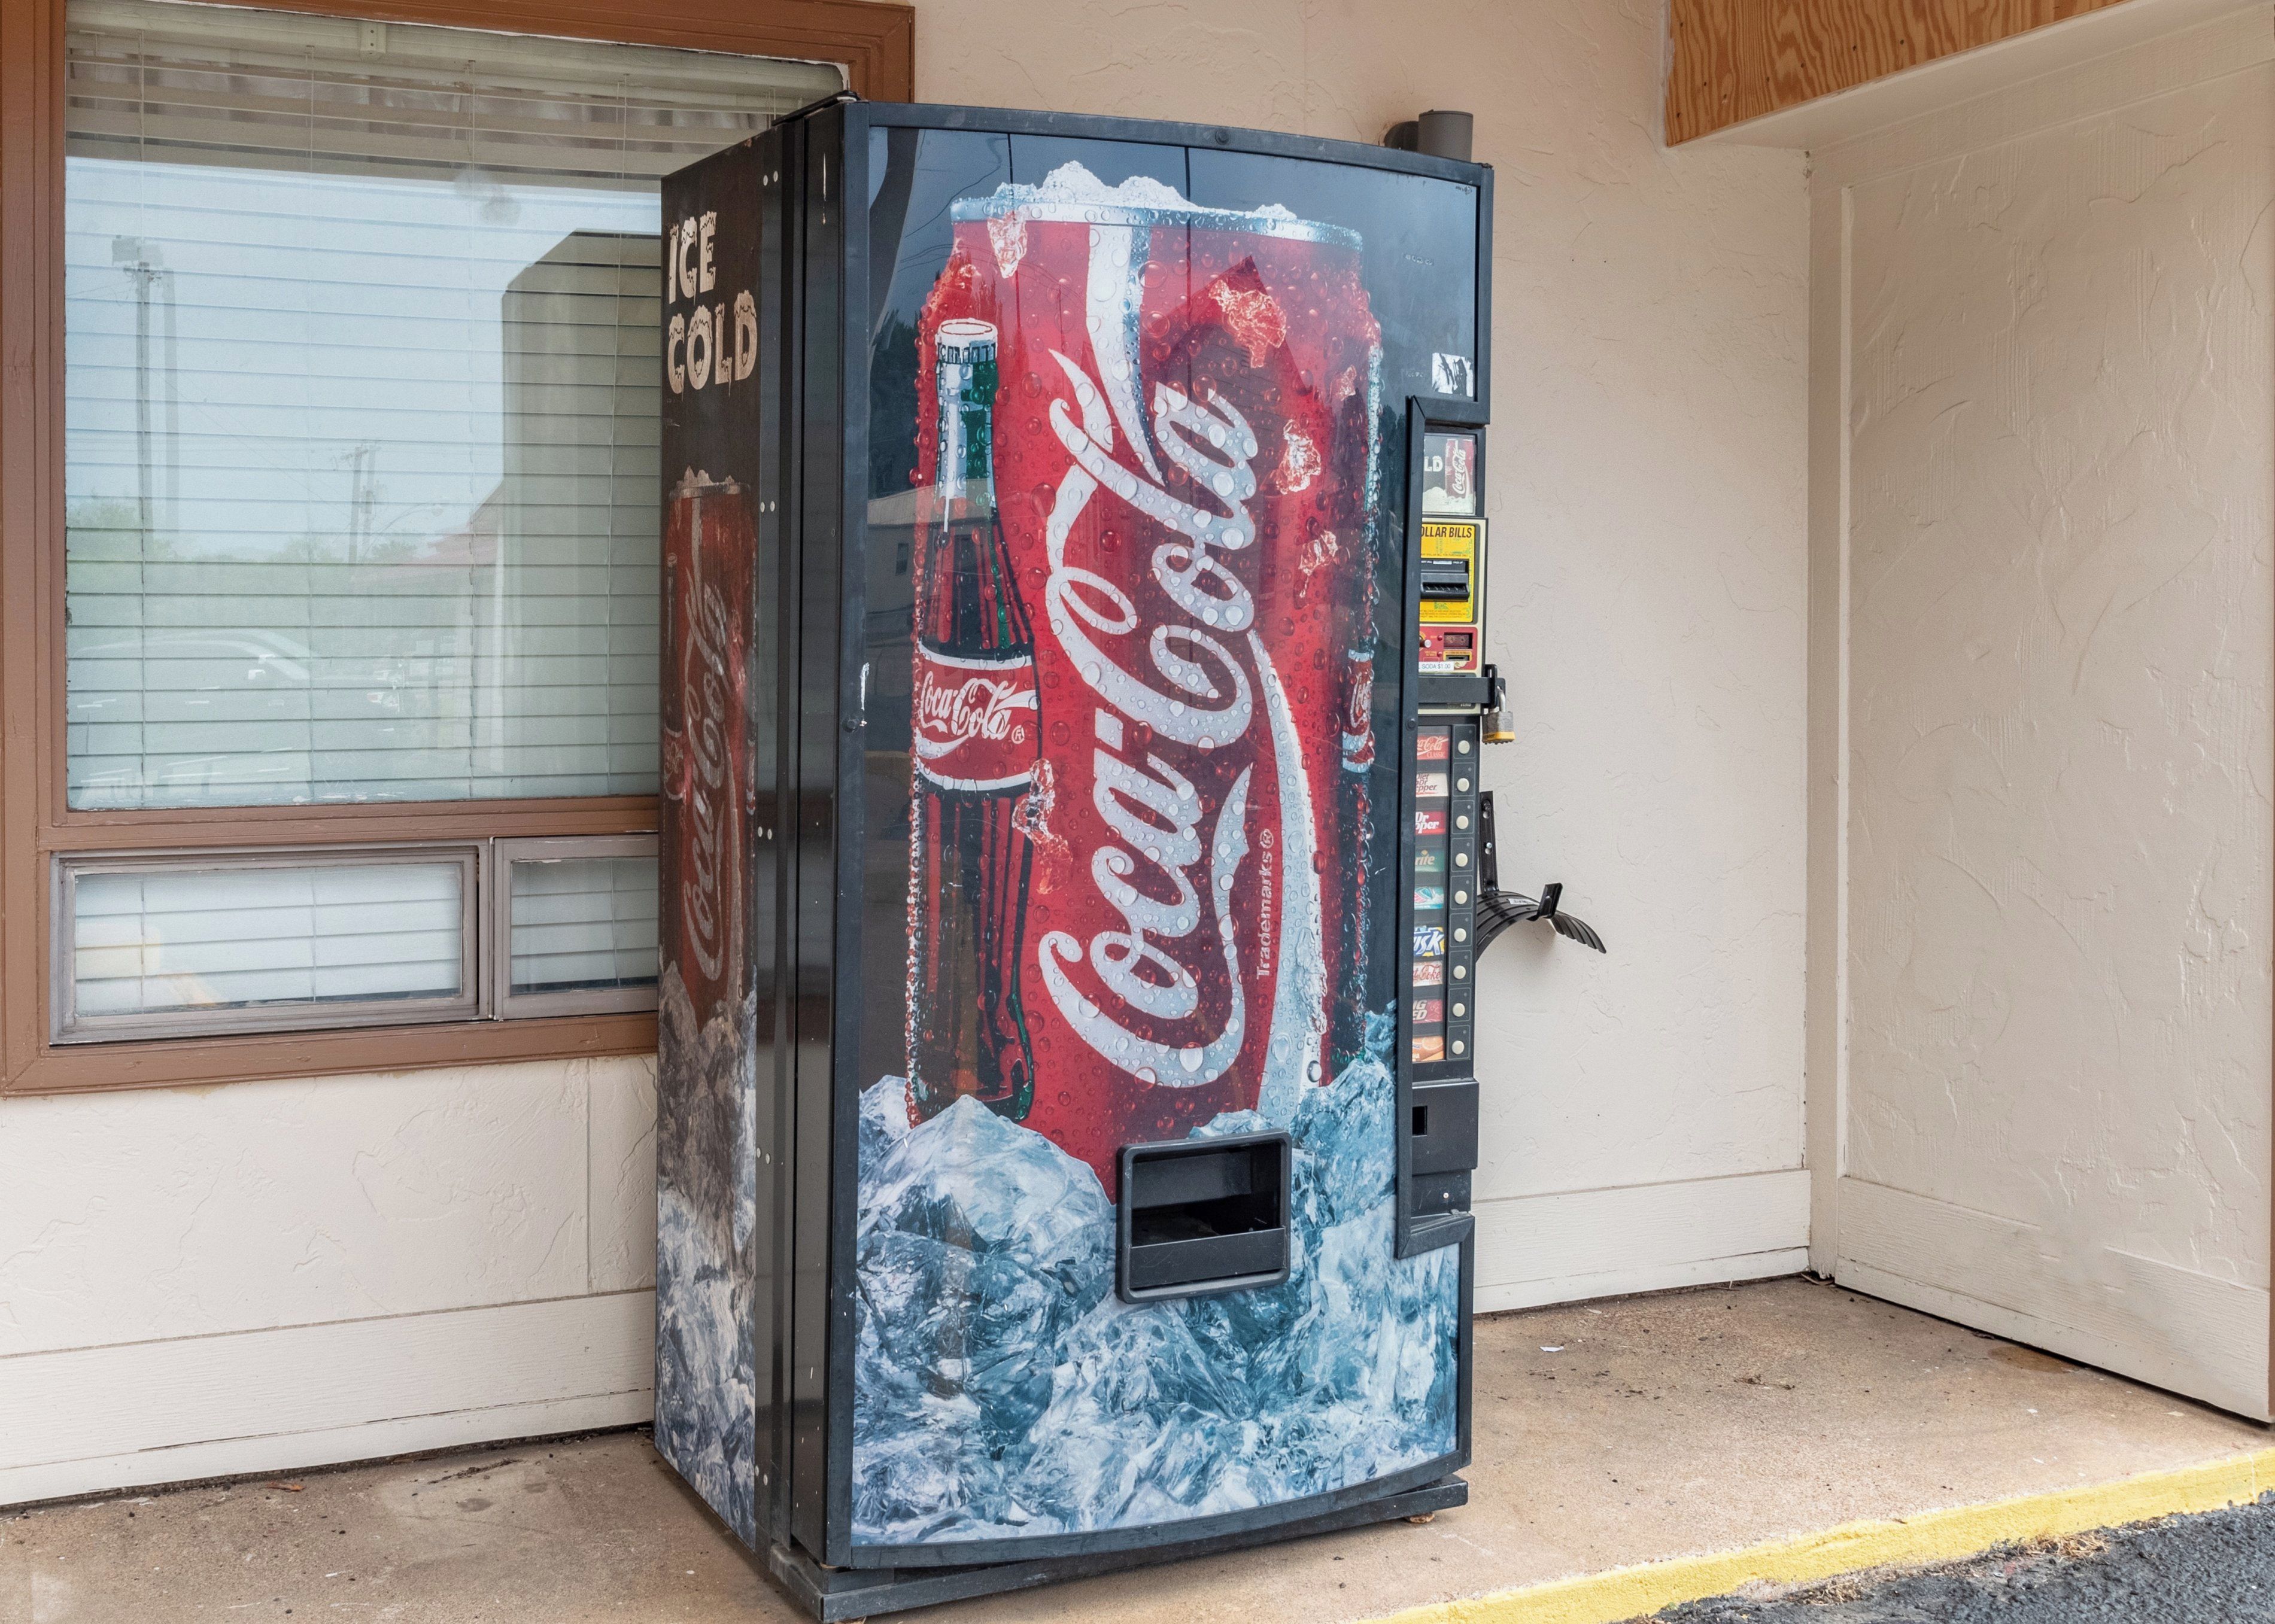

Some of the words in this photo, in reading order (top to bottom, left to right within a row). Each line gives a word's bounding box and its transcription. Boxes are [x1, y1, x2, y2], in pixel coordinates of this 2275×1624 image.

[669, 211, 718, 306] ICE
[667, 290, 758, 402] COLD
[1448, 527, 1472, 538] BILLS
[1040, 347, 1258, 1089] Coca-Cola
[684, 566, 731, 981] Coca-Cola
[1416, 811, 1429, 823] Dr
[1414, 930, 1445, 956] ISK
